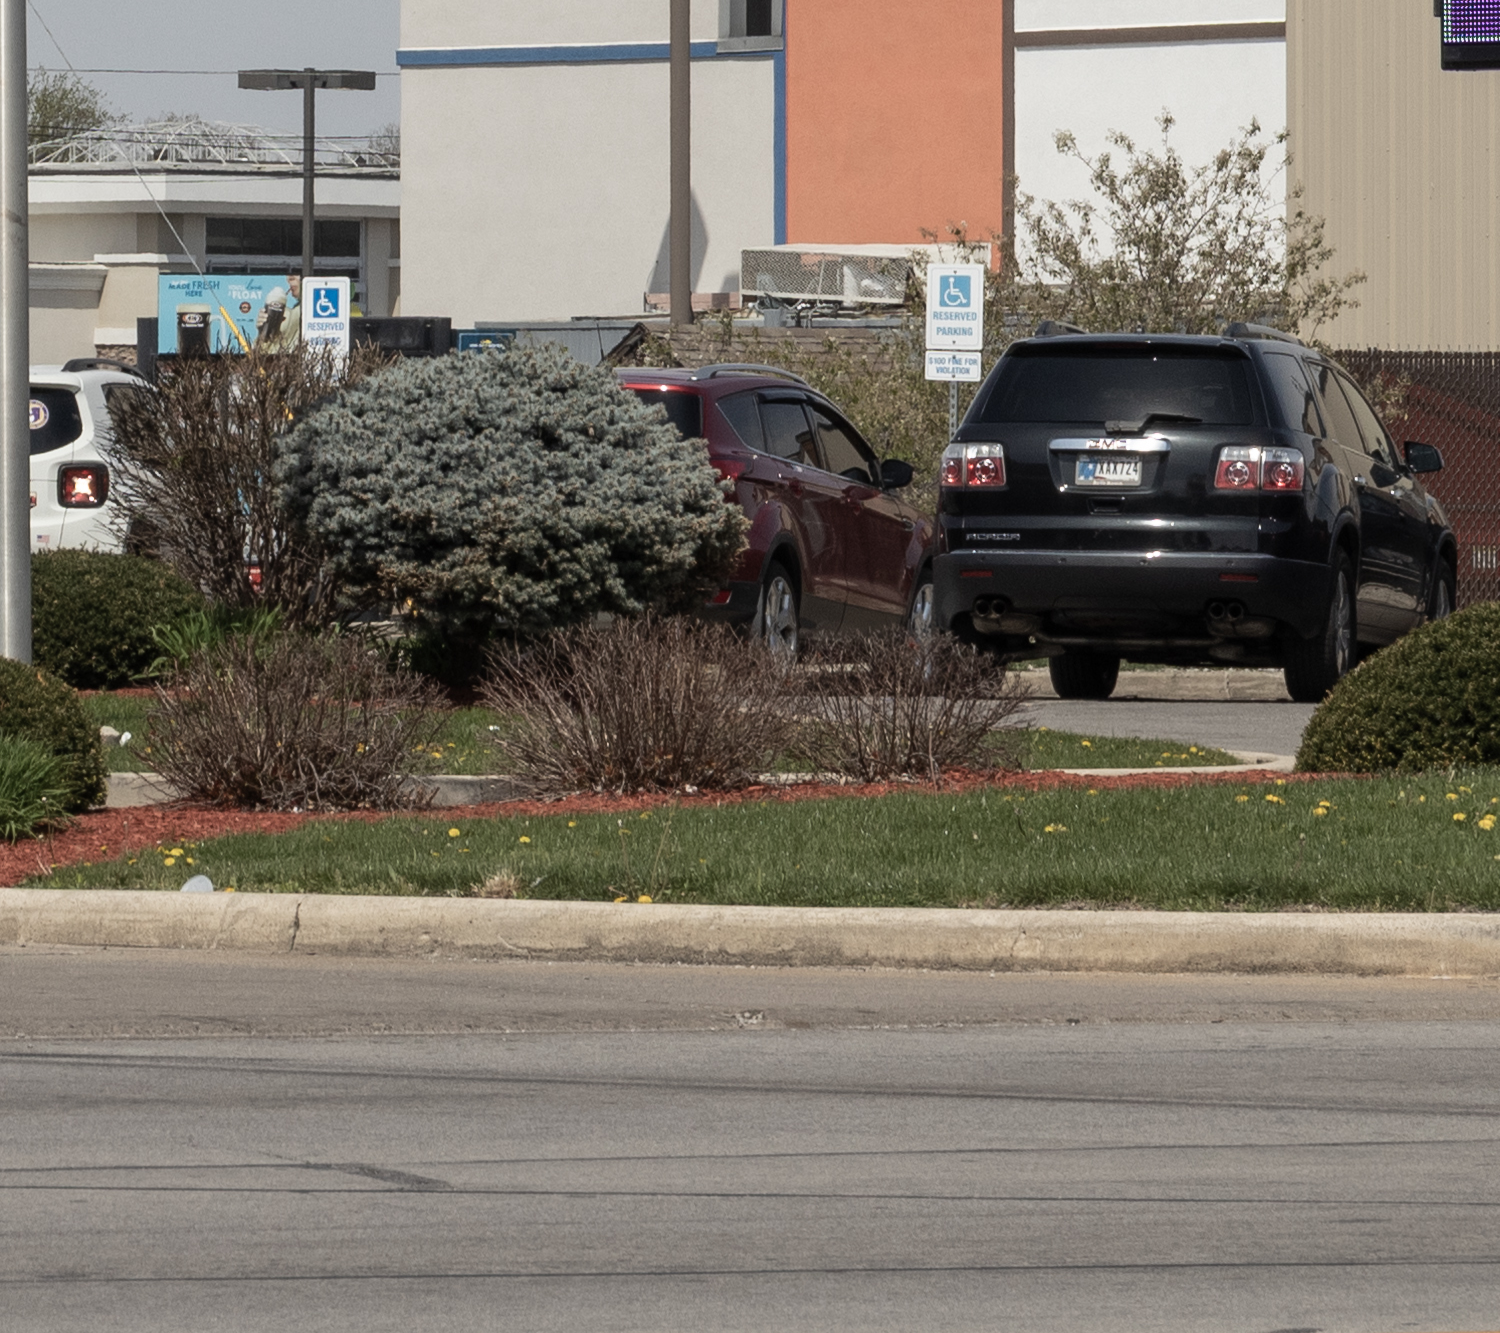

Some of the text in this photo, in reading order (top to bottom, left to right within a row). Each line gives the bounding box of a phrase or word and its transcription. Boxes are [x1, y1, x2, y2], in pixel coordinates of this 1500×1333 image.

[192, 280, 220, 290] FRESH
[232, 290, 263, 300] FLOAT
[932, 311, 977, 321] RESERVED
[307, 322, 345, 331] RESERVED
[936, 327, 973, 336] PARKING
[928, 357, 946, 366] $100
[964, 357, 977, 366] FOR
[936, 367, 971, 375] VIOLATION
[1098, 461, 1139, 475] XAX724
